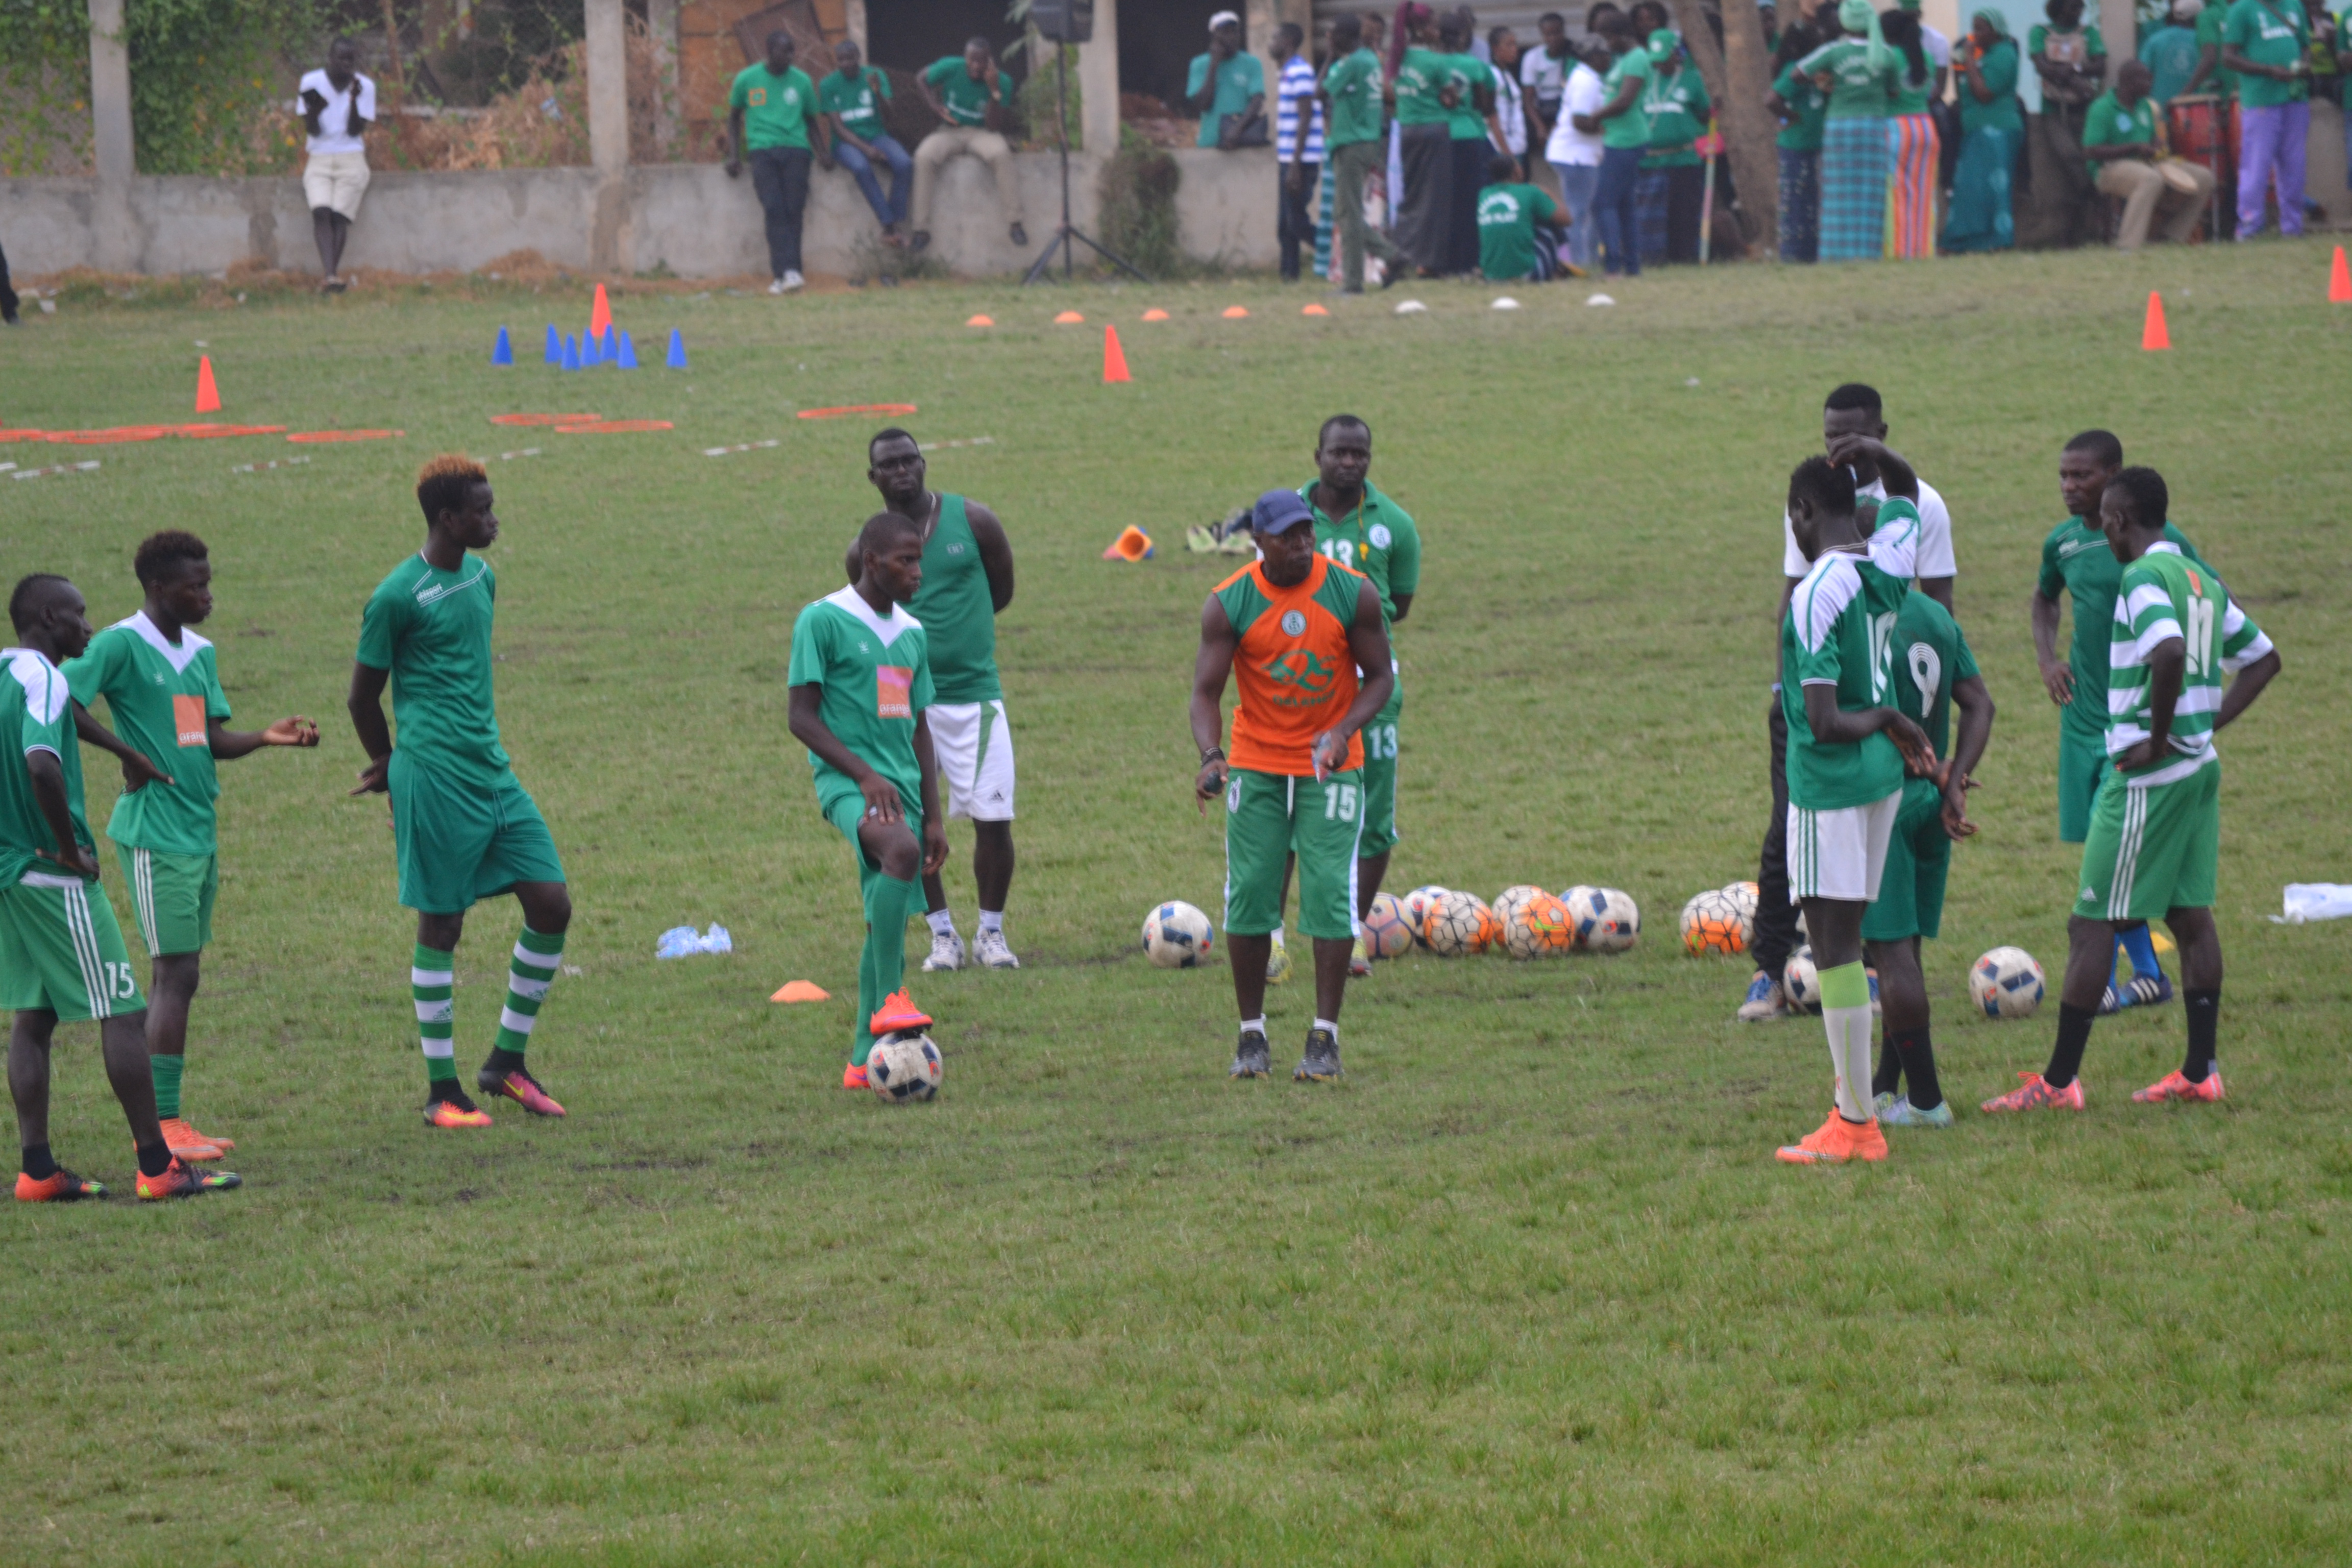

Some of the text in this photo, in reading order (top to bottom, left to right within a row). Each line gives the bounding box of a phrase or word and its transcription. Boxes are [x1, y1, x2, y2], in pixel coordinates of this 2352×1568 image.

[1321, 538, 1353, 568] 13
[1908, 642, 1941, 718] 9
[179, 731, 207, 745] orang
[1368, 724, 1397, 760] 13
[1325, 783, 1356, 823] 15
[105, 962, 134, 998] 15
